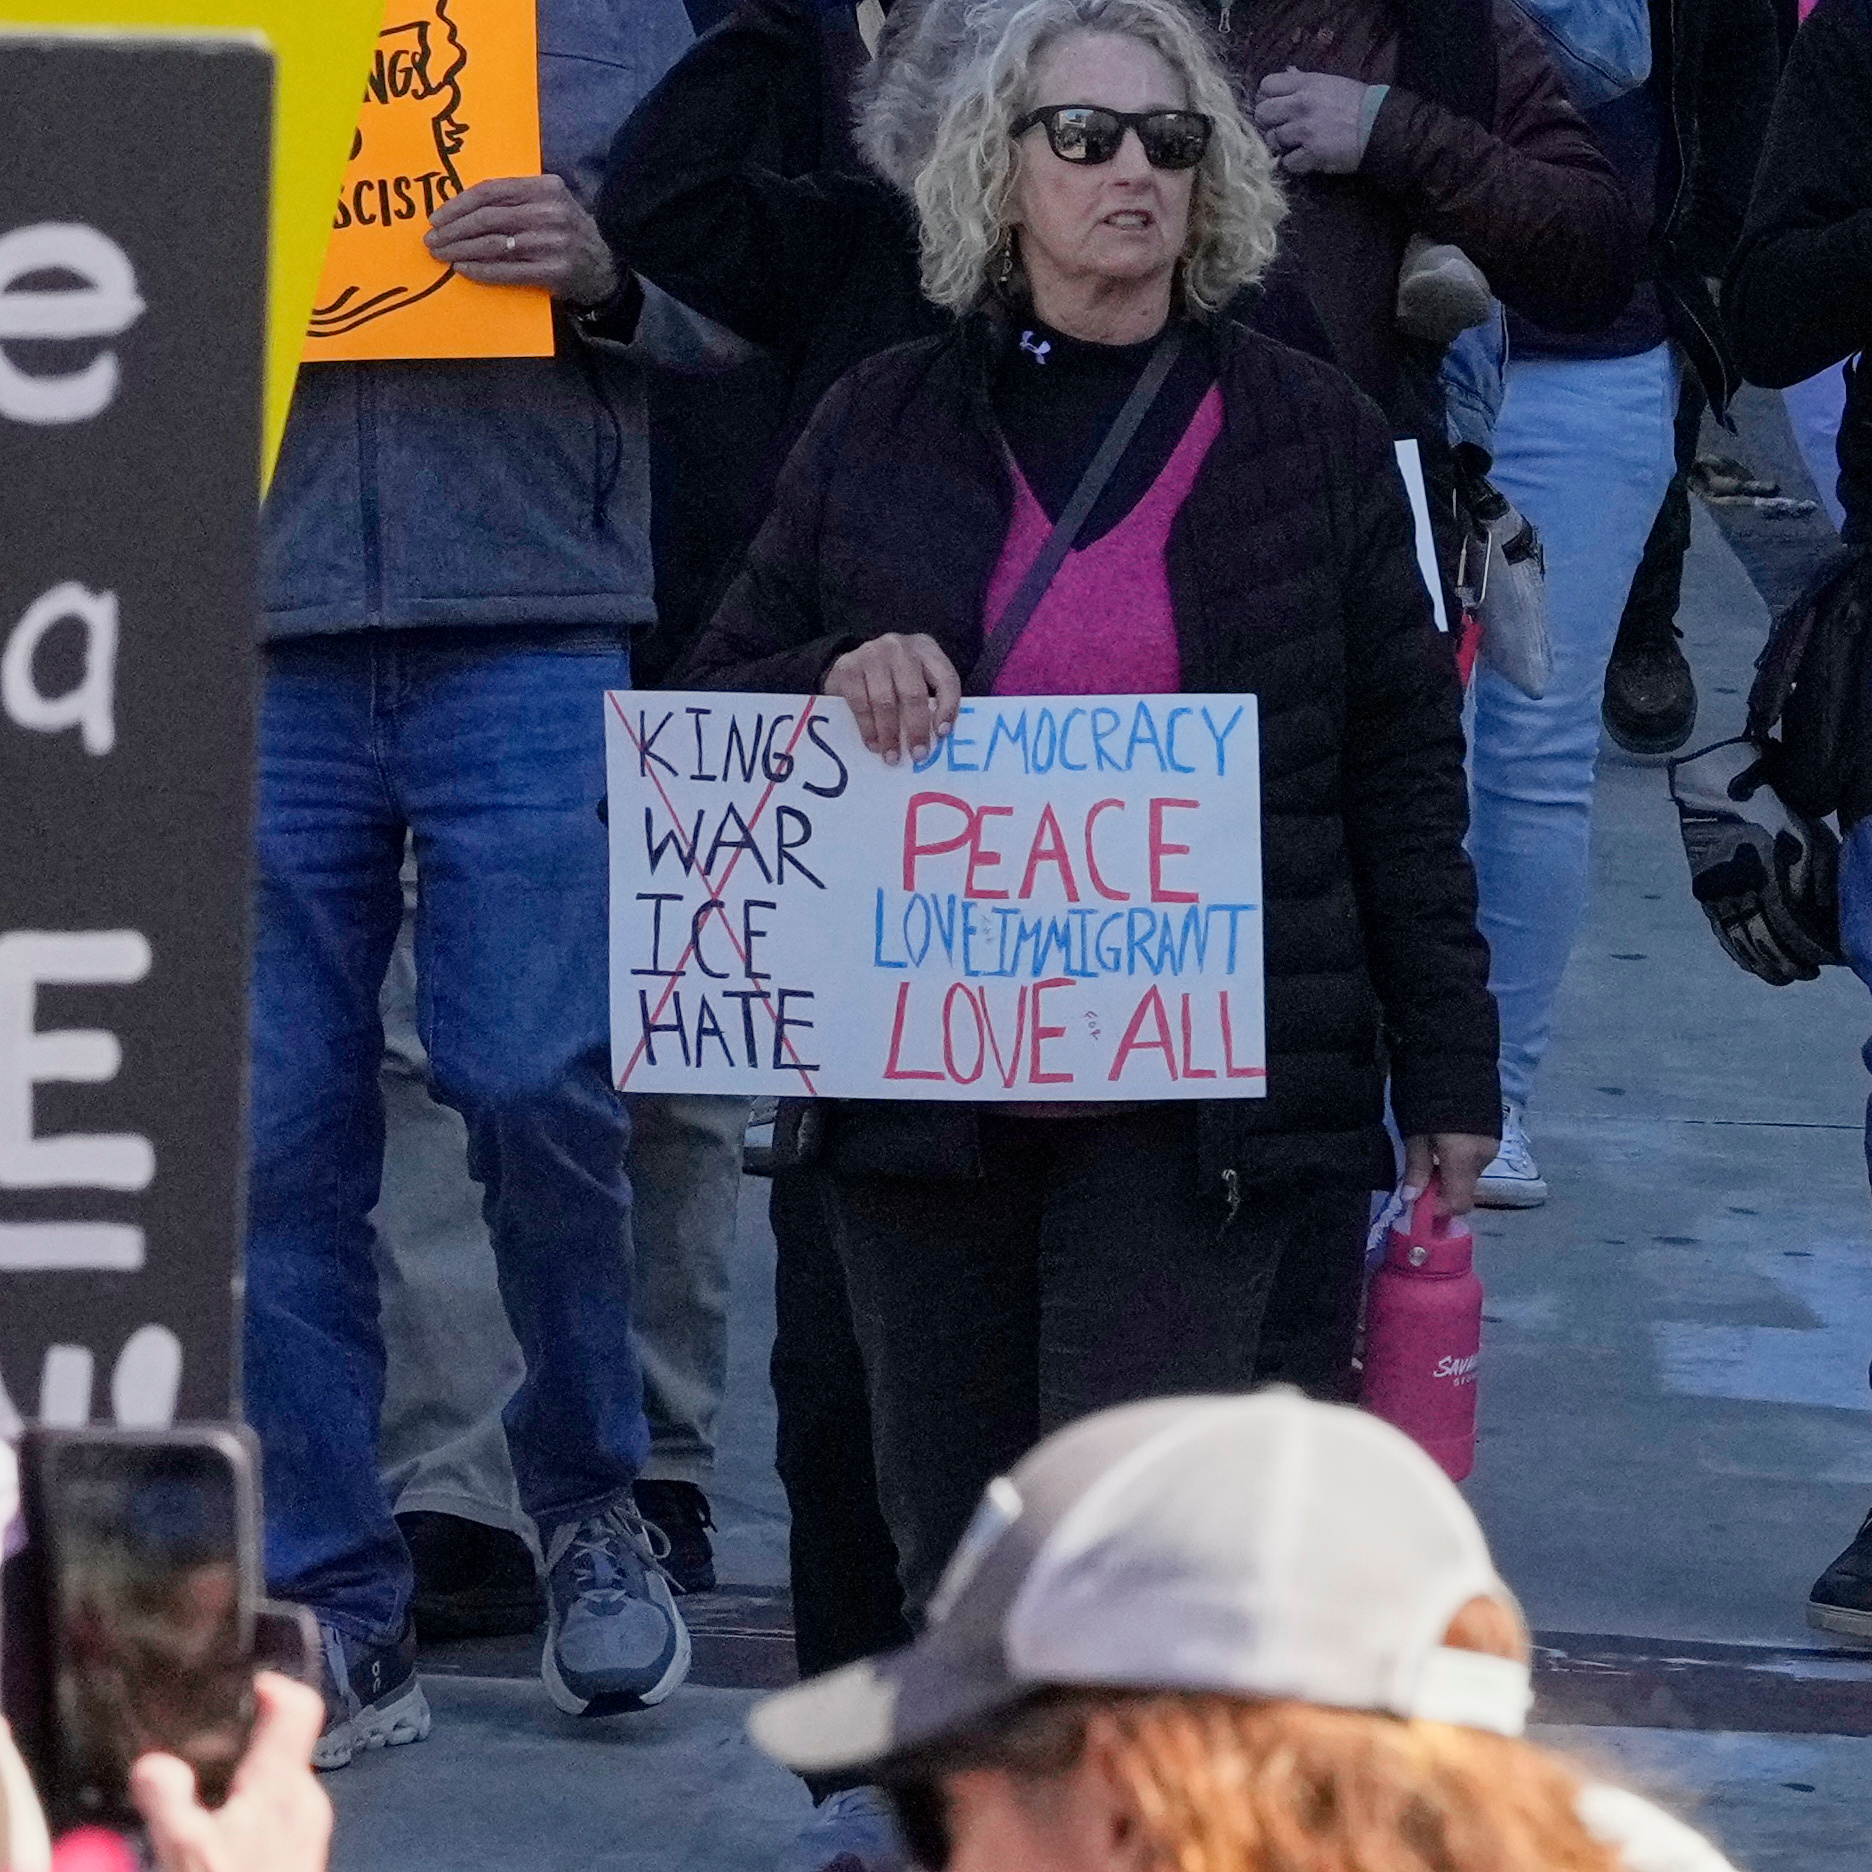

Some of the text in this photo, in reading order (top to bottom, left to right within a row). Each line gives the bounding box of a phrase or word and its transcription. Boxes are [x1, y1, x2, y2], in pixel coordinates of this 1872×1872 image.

[636, 698, 1245, 798] KINGS DEMOCRACY
[644, 790, 1202, 905] WAR PEACE
[630, 893, 778, 981] ICE
[638, 988, 821, 1073] HATE
[882, 977, 1077, 1088] LOVE
[1107, 983, 1268, 1082] ALL
